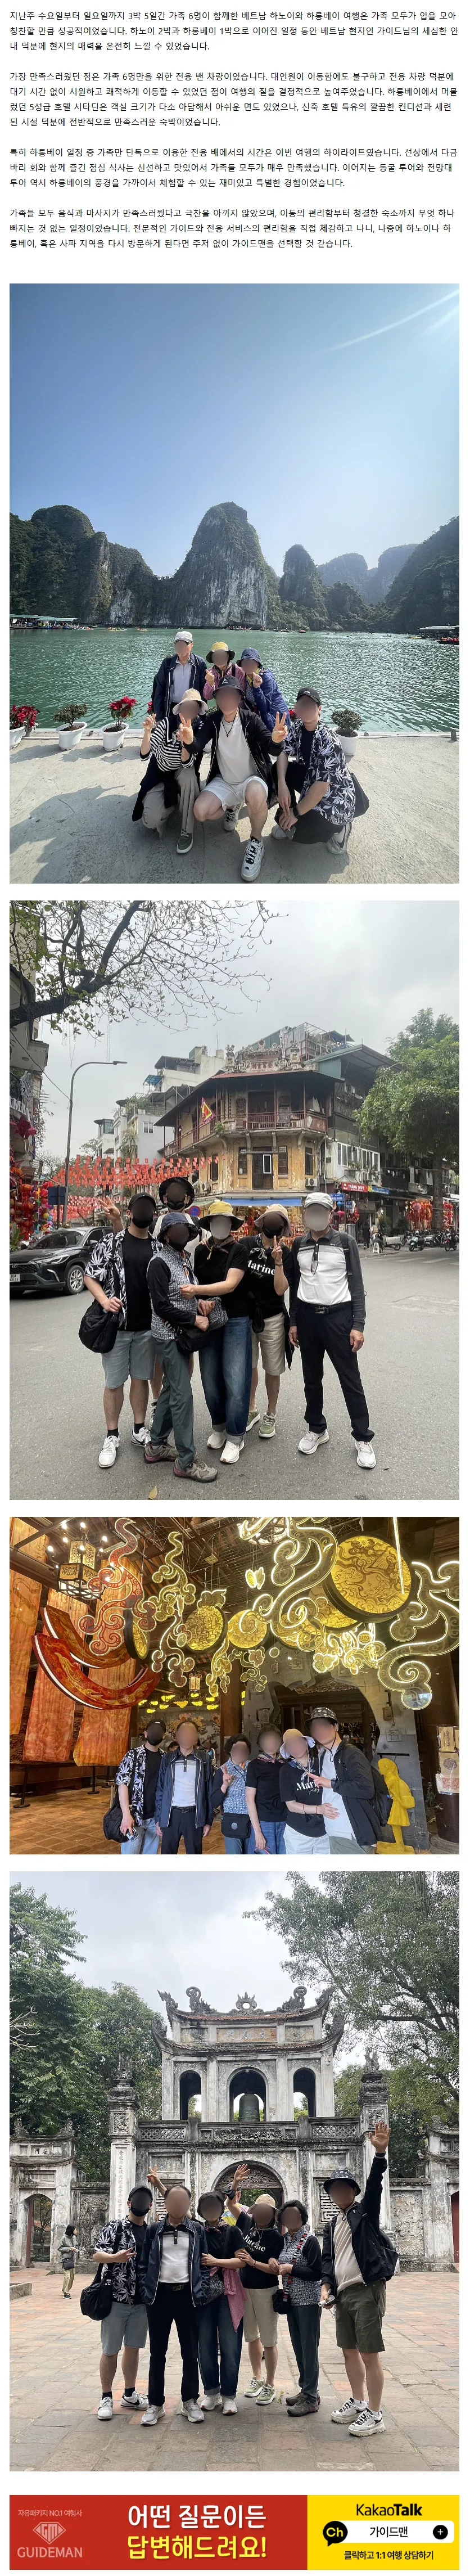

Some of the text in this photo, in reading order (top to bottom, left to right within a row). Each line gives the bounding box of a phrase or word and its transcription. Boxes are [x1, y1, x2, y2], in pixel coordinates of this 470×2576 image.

[356, 2503, 423, 2516] KakaoTalk
[128, 2505, 266, 2529] 어떤 질문이든
[326, 2527, 344, 2537] Ch
[369, 2526, 408, 2538] 가이드맨
[17, 2547, 83, 2558] GUIDEMAN
[128, 2535, 266, 2559] 답변해드려요!
[344, 2551, 374, 2560] 클릭하고
[387, 2551, 402, 2560] 여행
[403, 2551, 433, 2560] 상담하기
